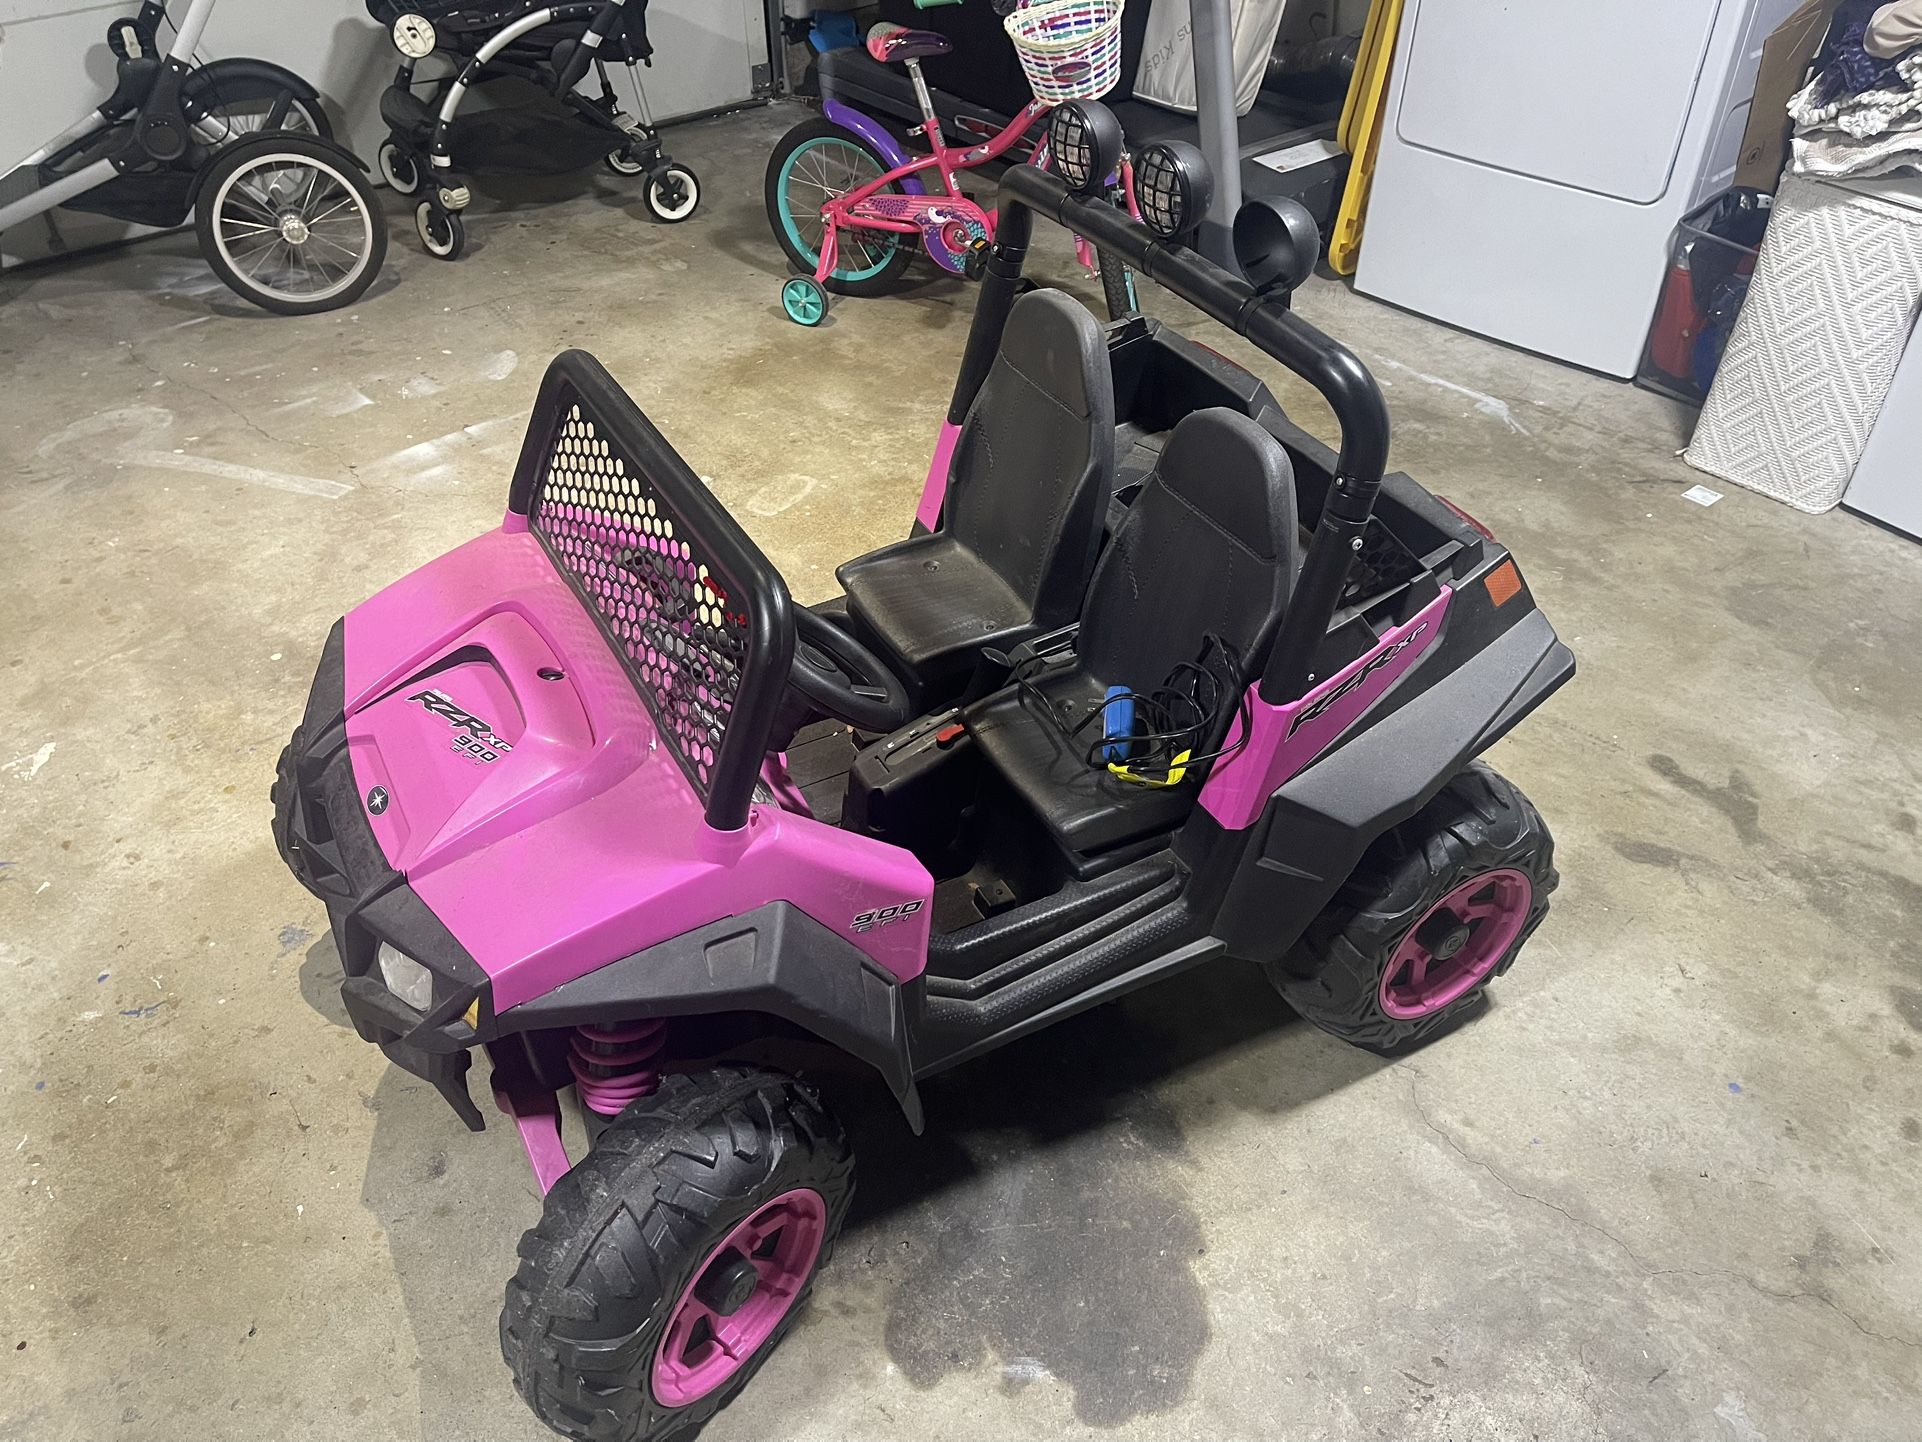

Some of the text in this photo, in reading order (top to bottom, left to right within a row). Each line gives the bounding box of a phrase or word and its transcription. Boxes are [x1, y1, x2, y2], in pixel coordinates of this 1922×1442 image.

[1144, 40, 1174, 73] Kids
[405, 689, 513, 752] RZR XP
[452, 734, 501, 763] 900
[849, 899, 925, 928] 900
